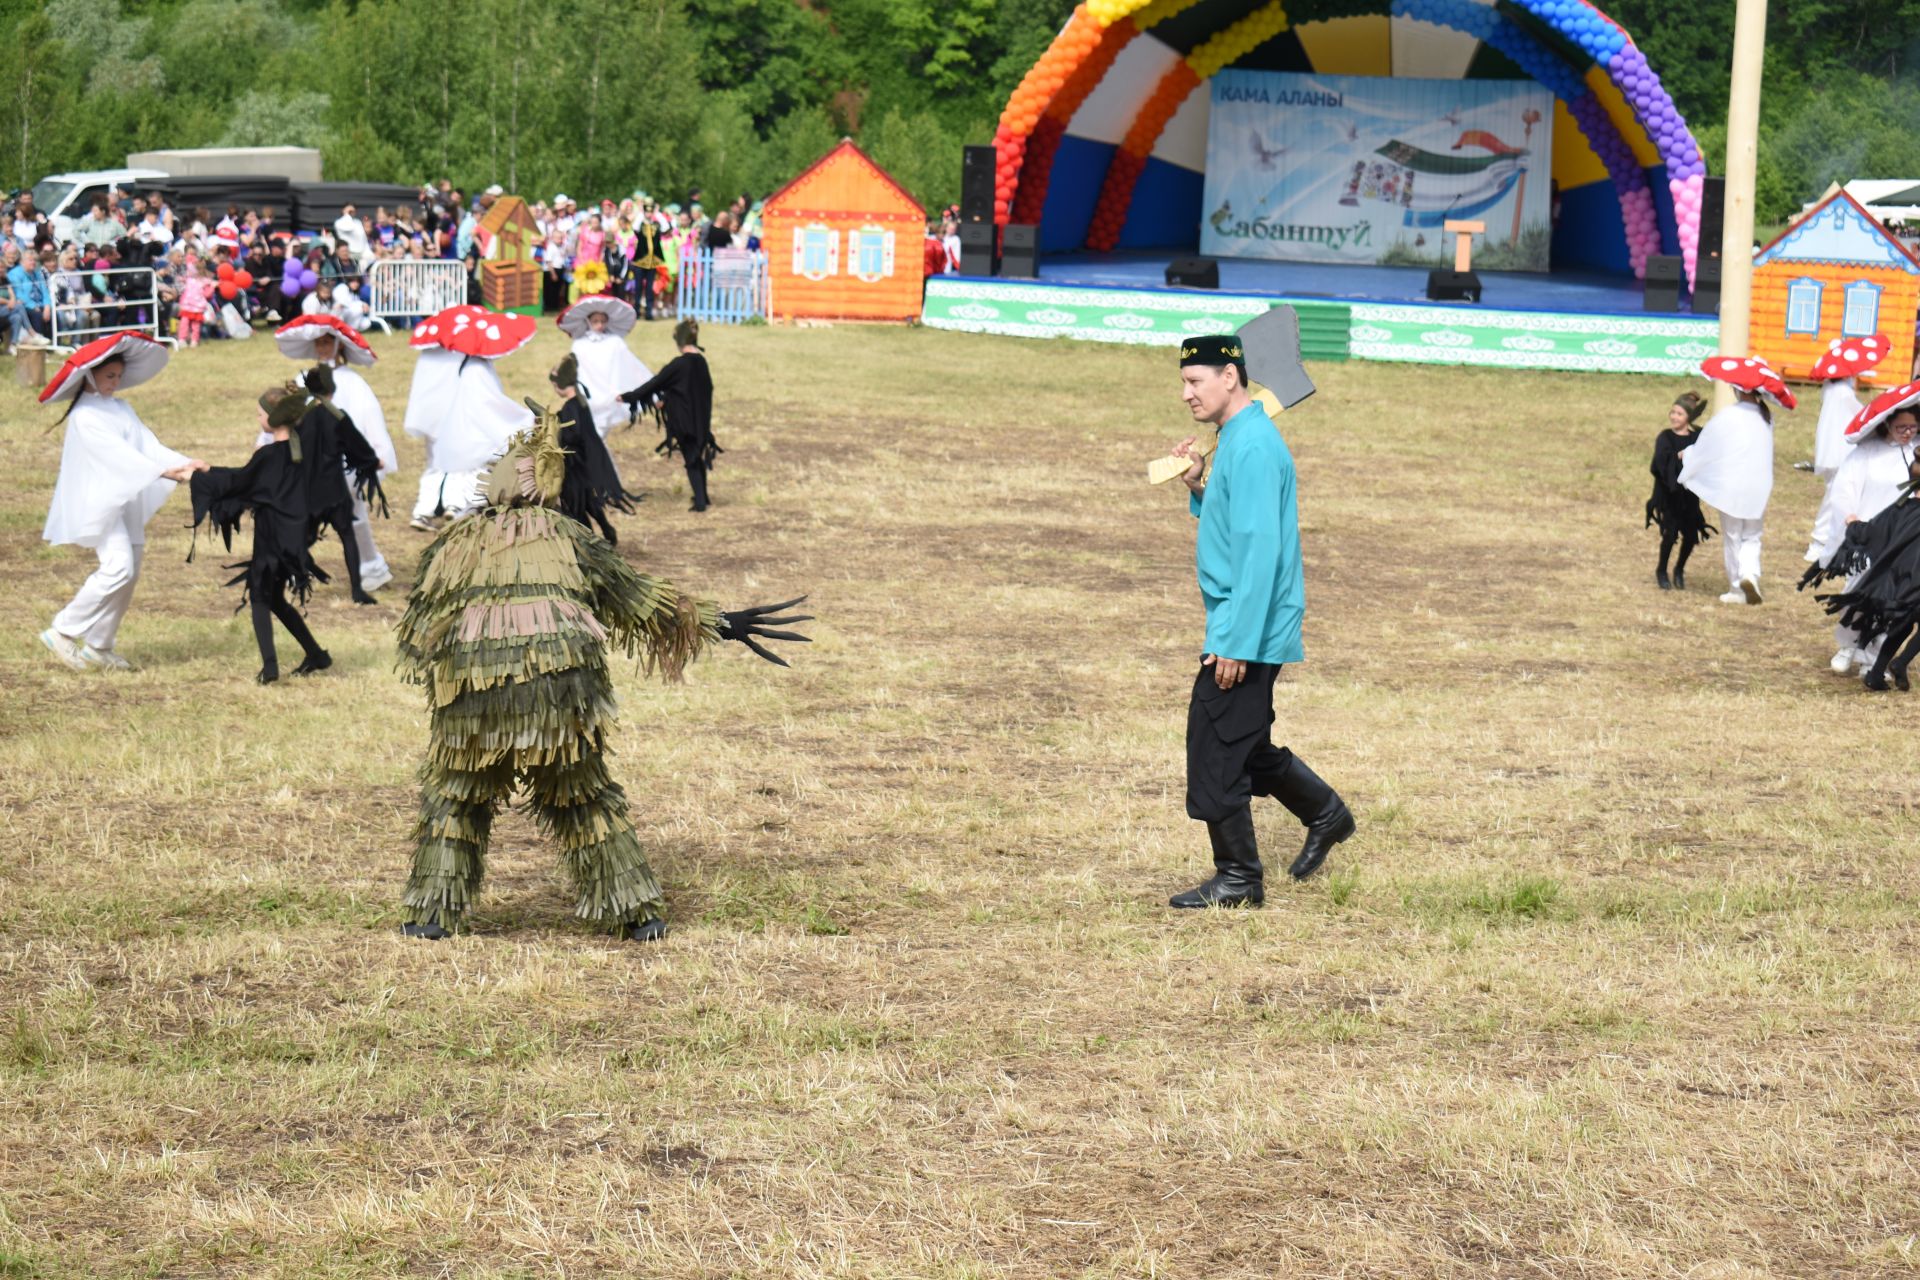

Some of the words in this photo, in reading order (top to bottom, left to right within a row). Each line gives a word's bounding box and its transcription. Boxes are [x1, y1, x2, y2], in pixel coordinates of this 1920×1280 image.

[1220, 85, 1270, 104] КАМА
[1276, 89, 1343, 108] АЛАНЫ
[1211, 207, 1372, 250] Сабантуй
